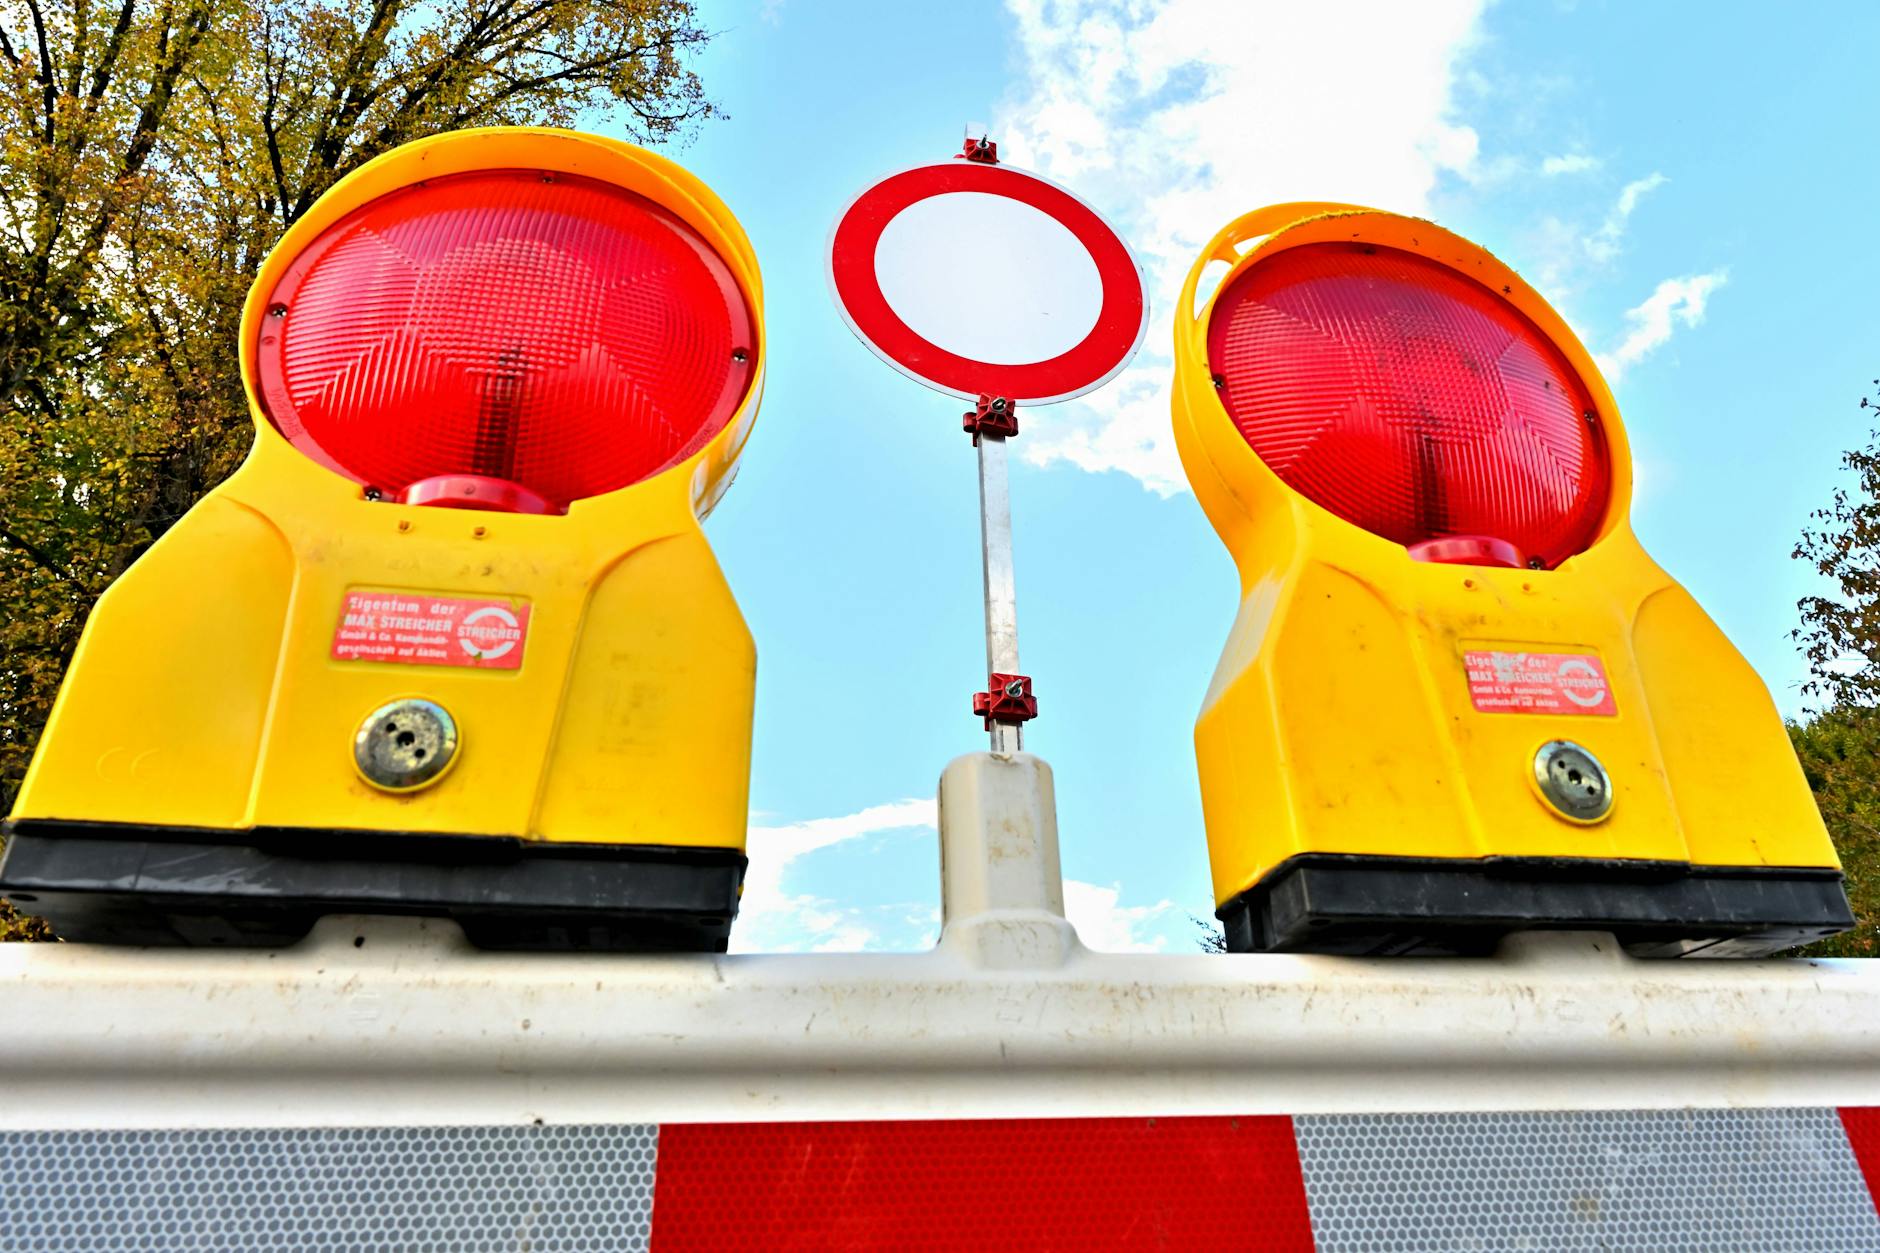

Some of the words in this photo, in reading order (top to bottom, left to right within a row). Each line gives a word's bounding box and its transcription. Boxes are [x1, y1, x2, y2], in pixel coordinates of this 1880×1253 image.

[349, 597, 420, 613] Eigentum
[430, 603, 456, 615] der
[344, 614, 376, 628] MAX
[380, 616, 453, 632] STREICHER
[457, 626, 521, 640] STREICHER
[1469, 671, 1493, 682] MAX
